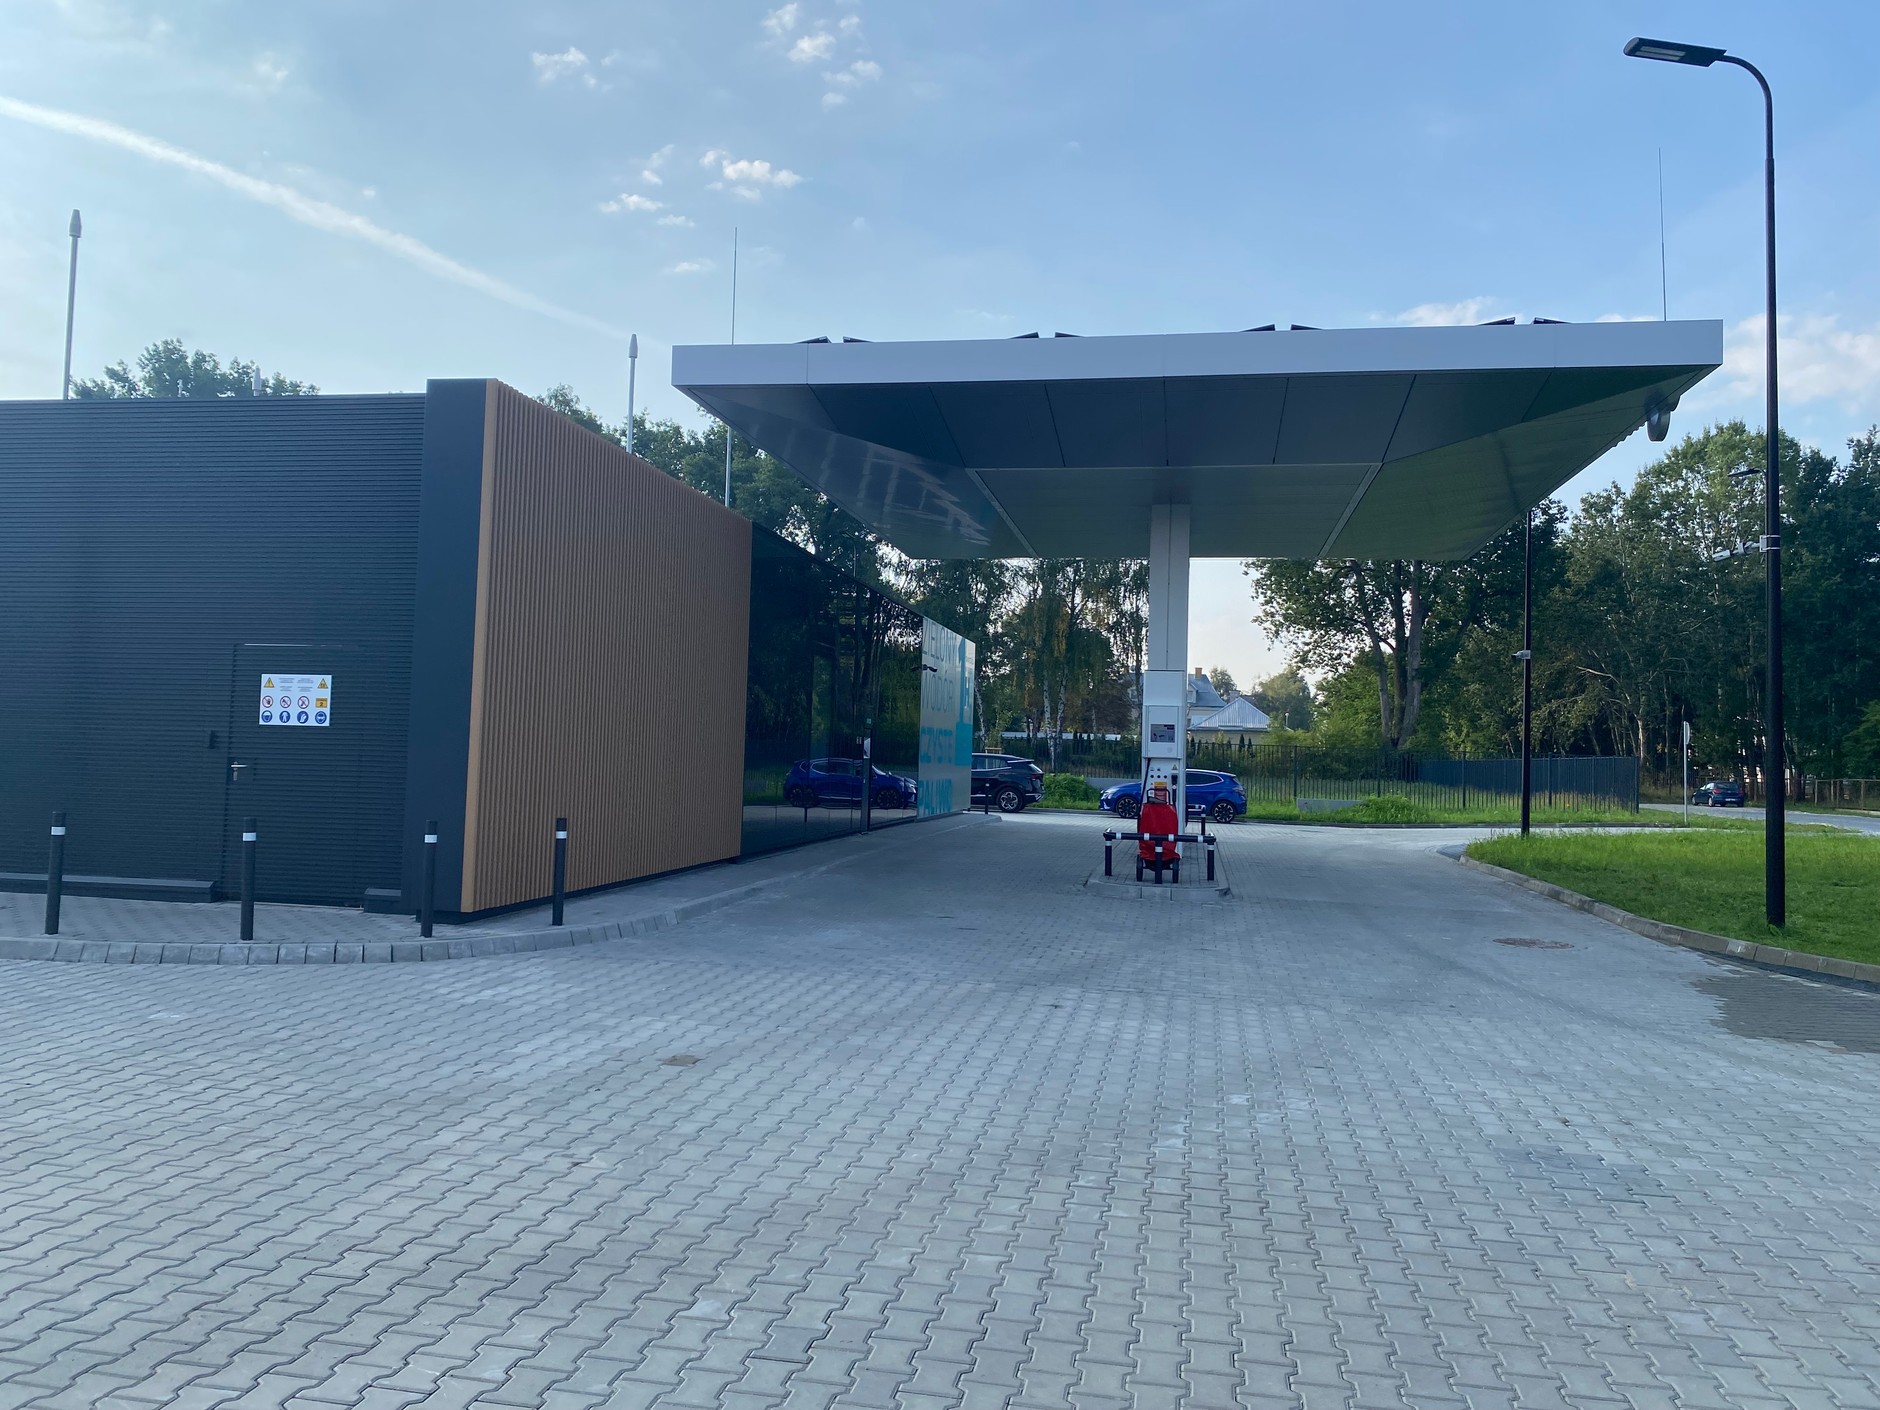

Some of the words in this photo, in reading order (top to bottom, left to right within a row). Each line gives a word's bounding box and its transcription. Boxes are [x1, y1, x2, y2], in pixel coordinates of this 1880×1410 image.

[922, 618, 956, 665] ZIELONY
[921, 669, 954, 713] WODÓR
[918, 778, 952, 816] PALIWO
